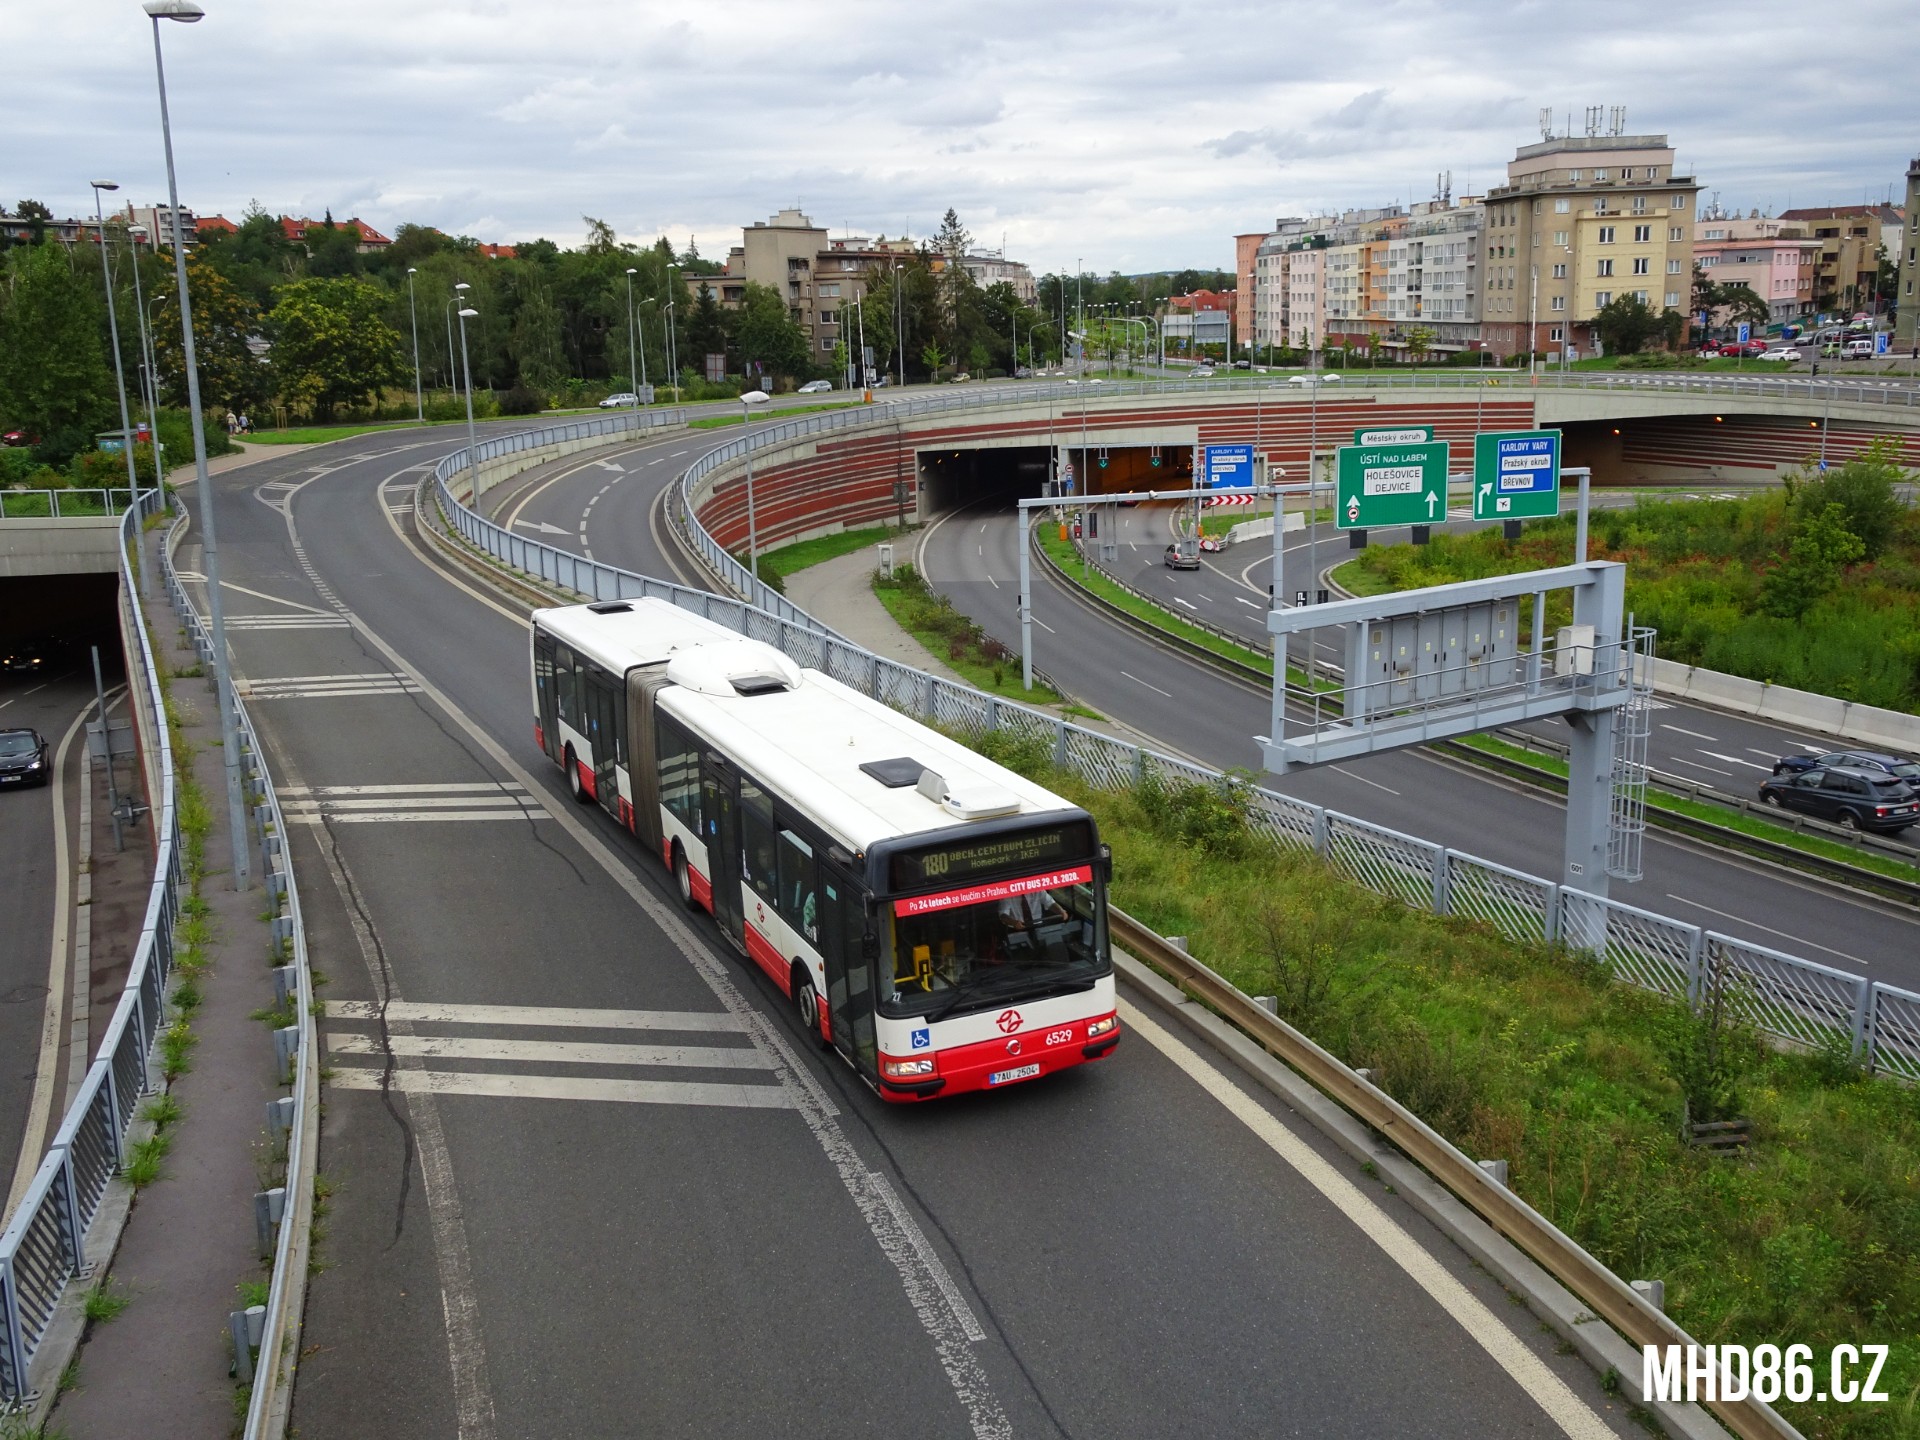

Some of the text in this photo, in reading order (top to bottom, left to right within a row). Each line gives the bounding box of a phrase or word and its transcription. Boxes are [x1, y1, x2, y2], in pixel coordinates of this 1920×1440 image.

[1367, 433, 1397, 442] Městský
[1501, 441, 1548, 452] KARLOVY VARY
[1360, 452, 1428, 464] ÚSTÍ NAD LABEM
[1503, 457, 1548, 468] Pražský okruh
[1366, 469, 1420, 480] HOLEŠOVICE
[1503, 476, 1531, 486] BŘEVNOV
[1375, 482, 1410, 492] DEJVICE
[971, 853, 1011, 869] Homepark
[1021, 848, 1040, 859] IKEA
[922, 853, 949, 877] 180
[1571, 864, 1582, 873] 601
[909, 901, 918, 911] Po
[919, 900, 928, 910] 24
[928, 897, 951, 908] letech
[952, 896, 960, 904] se
[960, 891, 981, 903] loučím
[986, 886, 1010, 898] Prahou.
[1010, 881, 1026, 893] CITY
[1026, 879, 1041, 890] BUS
[1061, 871, 1080, 883] 2020.
[892, 992, 901, 1002] 27
[1045, 1029, 1072, 1046] 6529
[996, 1071, 1012, 1082] 7AU
[1016, 1066, 1036, 1078] 2504
